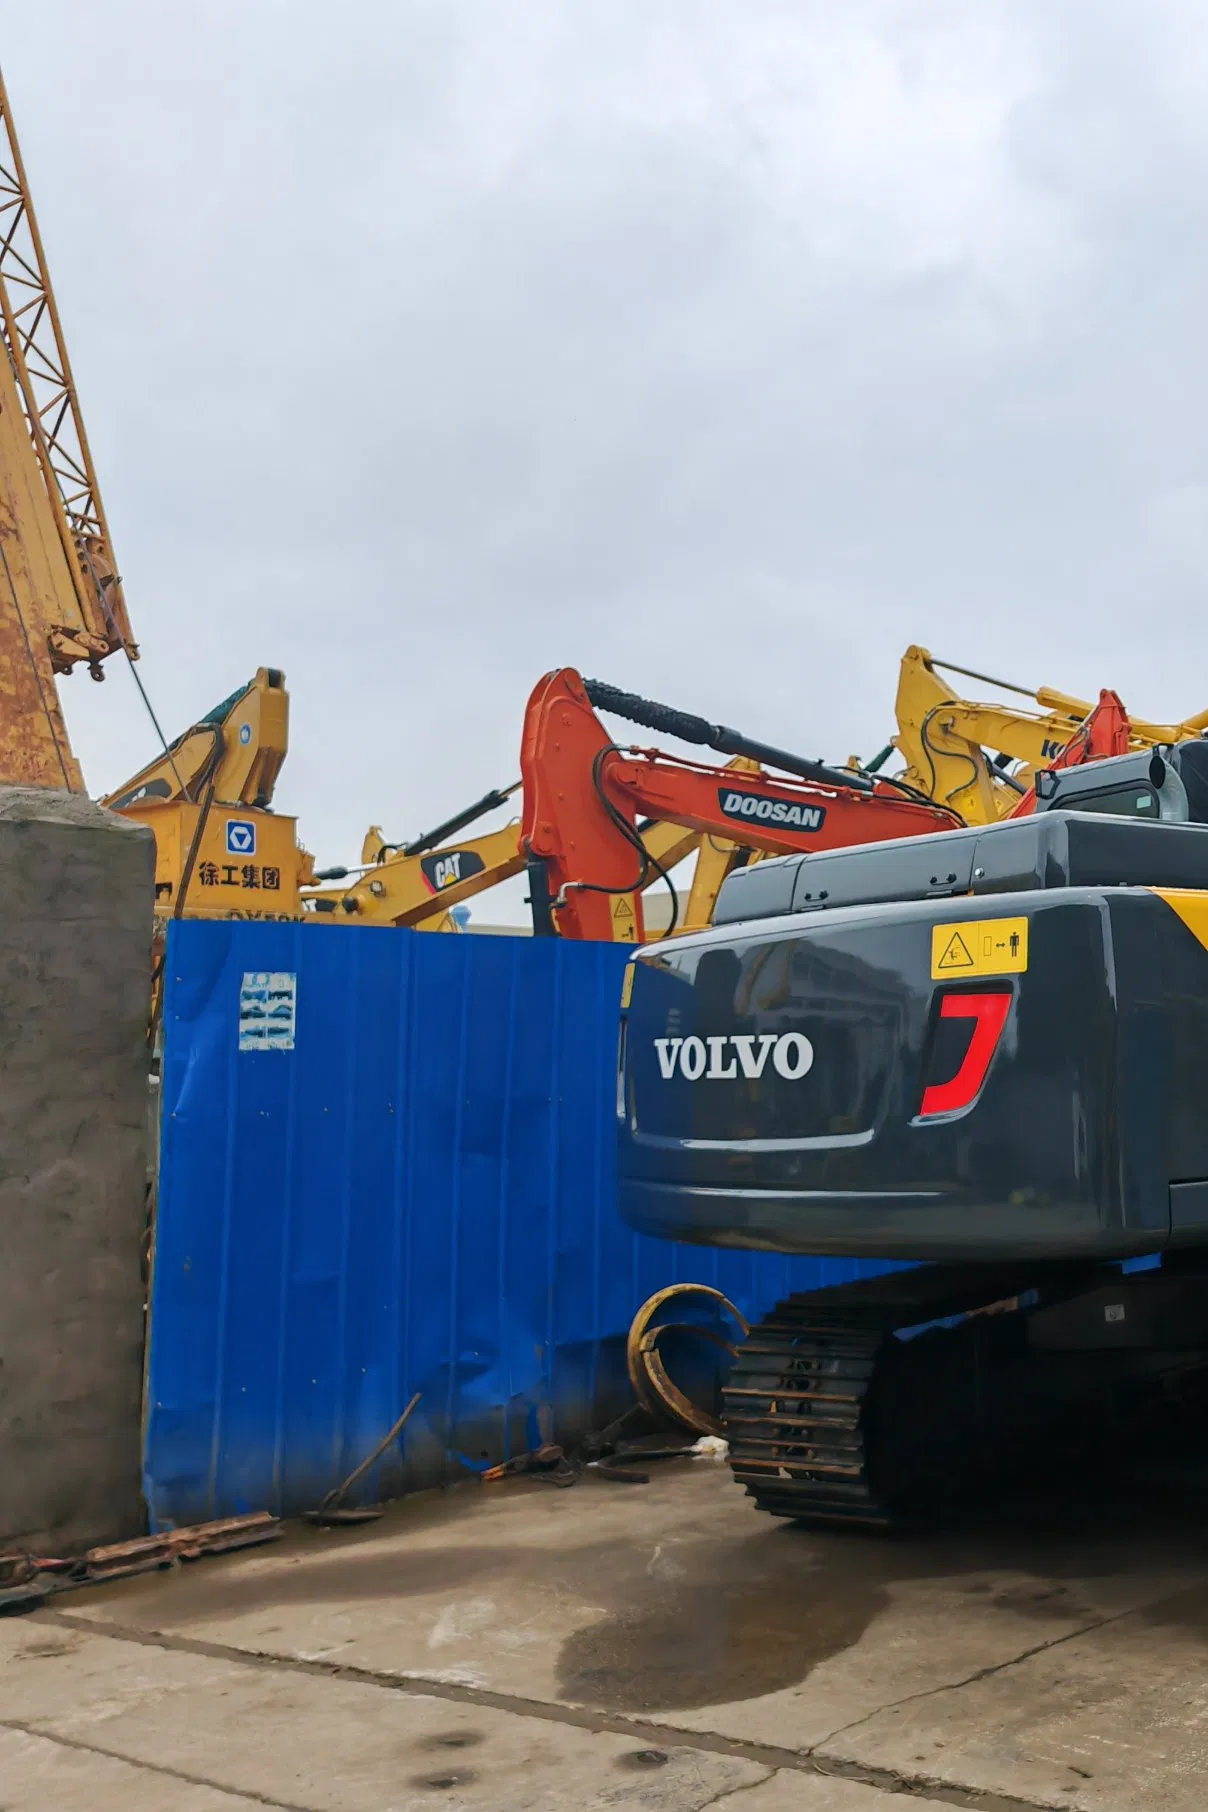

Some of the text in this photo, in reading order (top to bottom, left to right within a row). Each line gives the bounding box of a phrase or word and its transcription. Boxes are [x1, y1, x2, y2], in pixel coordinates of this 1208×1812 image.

[723, 793, 821, 828] DOOSAN
[199, 861, 281, 890] 徐工集团
[434, 852, 461, 889] CAT
[654, 1032, 814, 1081] VOLVO
